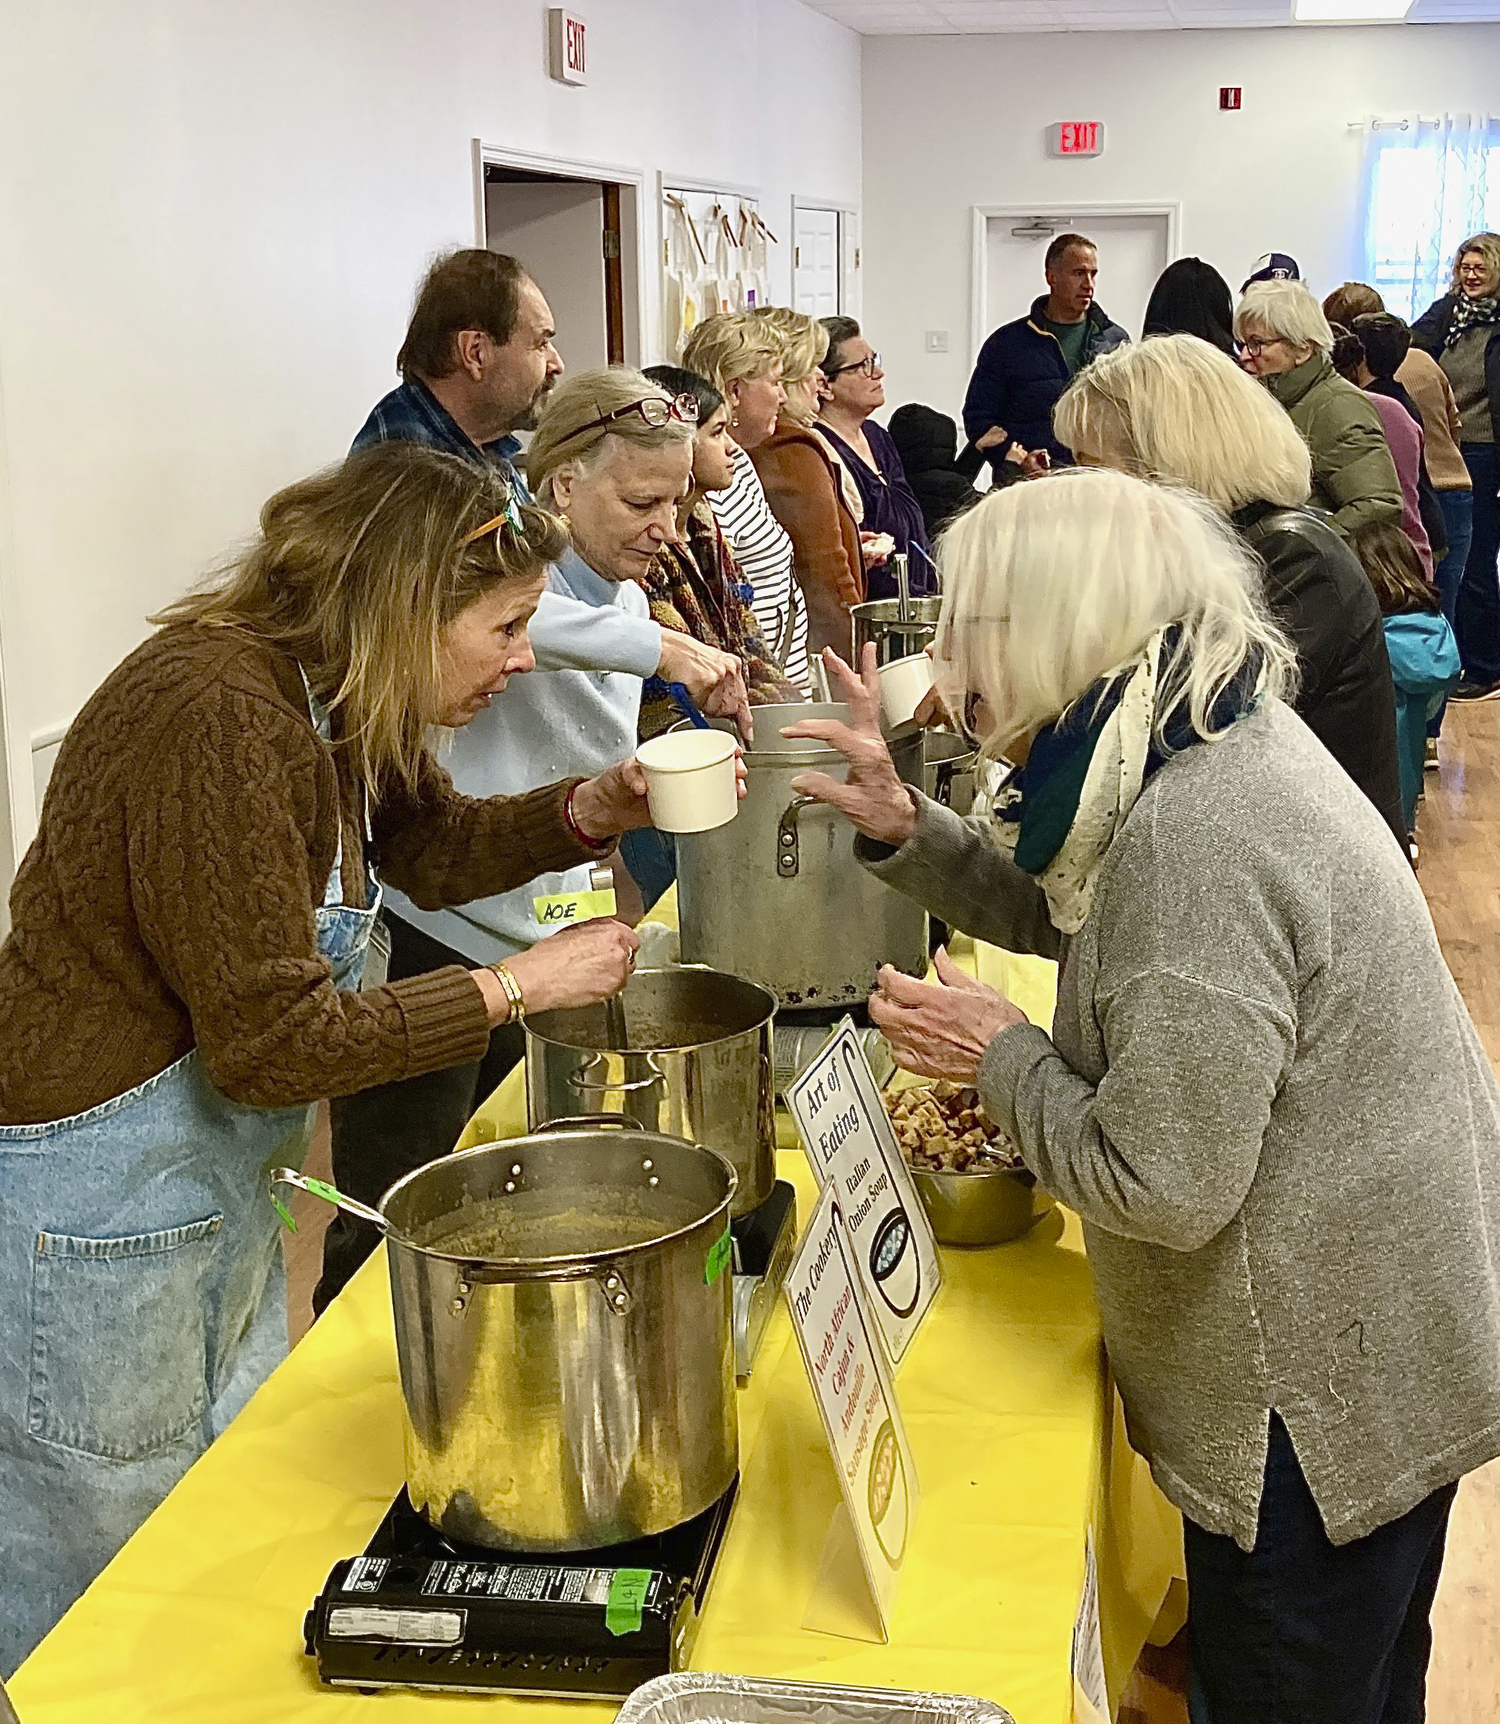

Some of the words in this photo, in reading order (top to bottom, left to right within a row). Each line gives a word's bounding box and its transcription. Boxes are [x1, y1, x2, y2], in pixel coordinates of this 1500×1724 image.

[566, 18, 585, 74] EXIT
[1061, 122, 1098, 152] EXIT
[543, 902, 577, 920] AOE
[806, 1078, 828, 1119] Art
[827, 1056, 841, 1092] of
[818, 1104, 860, 1164] Eating
[845, 1157, 871, 1195] Italian
[848, 1198, 872, 1232] Onion
[868, 1173, 888, 1202] Soup
[795, 1286, 812, 1325] The
[809, 1226, 838, 1291] Cookery
[815, 1331, 834, 1383] North
[831, 1285, 851, 1340] African
[832, 1349, 850, 1395] Cajun
[846, 1331, 855, 1354] &
[841, 1363, 865, 1438] Andouille
[846, 1418, 869, 1487] Sausage
[864, 1381, 880, 1424] Soup
